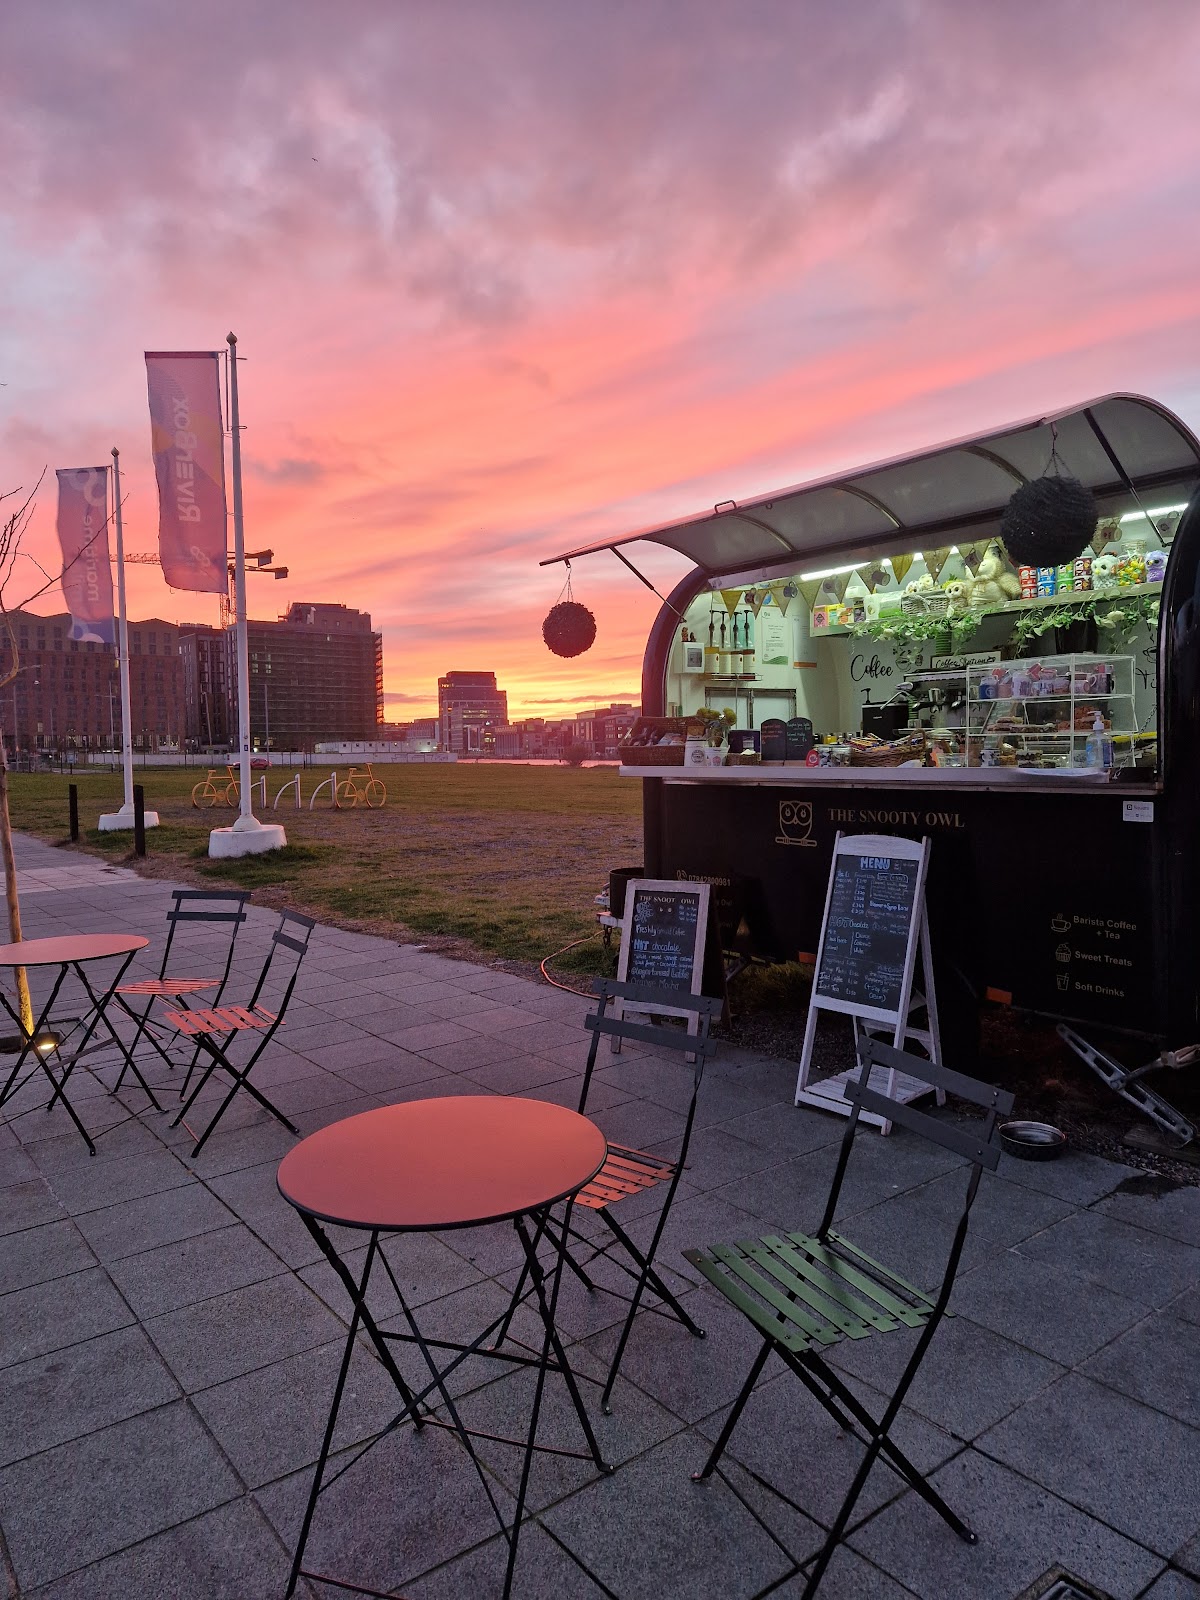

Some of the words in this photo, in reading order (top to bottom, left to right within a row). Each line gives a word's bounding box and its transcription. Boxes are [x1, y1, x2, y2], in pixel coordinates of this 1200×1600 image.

[850, 654, 893, 681] Coffee
[936, 658, 960, 669] Coffee
[829, 808, 856, 822] THE
[860, 811, 920, 826] SNOOTY
[926, 815, 966, 828] OWL
[860, 857, 890, 870] MENU
[1073, 915, 1104, 927] Barista
[1107, 919, 1136, 931] Coffee
[636, 924, 656, 937] Freshly
[1105, 930, 1121, 940] Tea
[634, 939, 649, 951] HOT
[652, 941, 681, 952] chocolate
[1075, 950, 1101, 962] Sweet
[1104, 955, 1133, 967] Treats
[1075, 981, 1093, 992] Soft
[1095, 985, 1124, 998] Drinks
